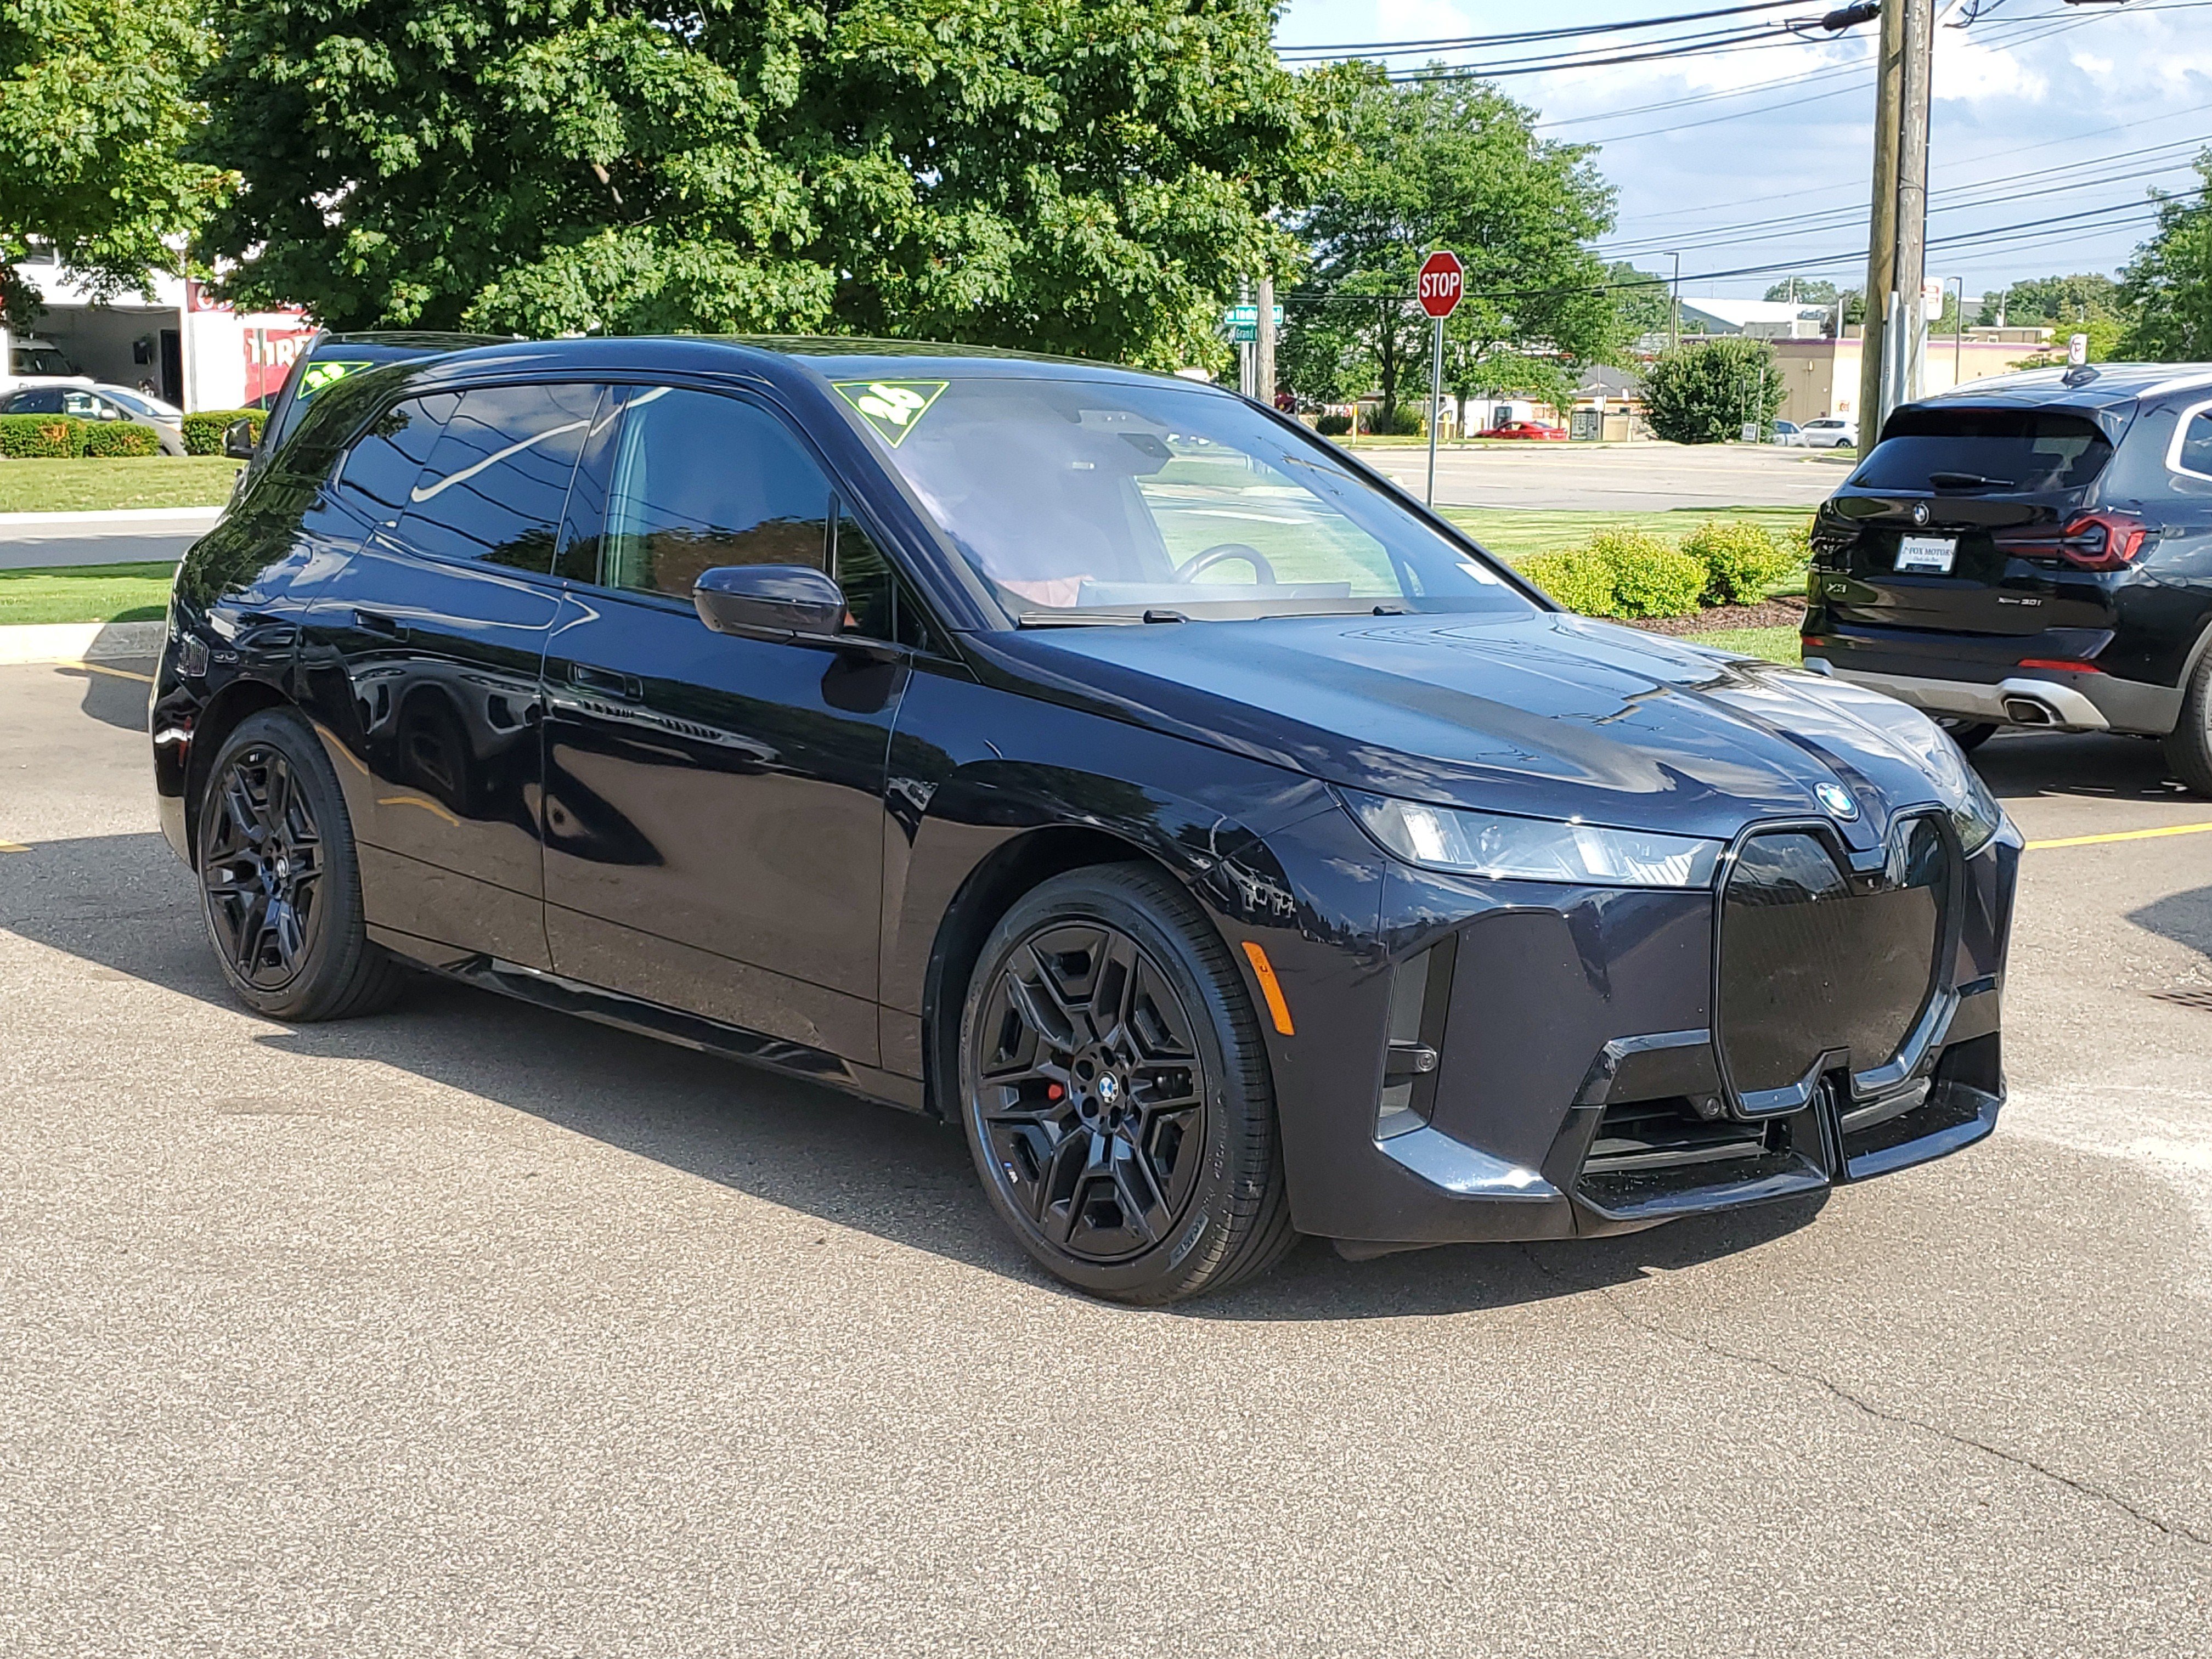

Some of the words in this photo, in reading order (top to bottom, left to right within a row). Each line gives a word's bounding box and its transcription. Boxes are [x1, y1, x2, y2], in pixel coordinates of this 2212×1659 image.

[1421, 272, 1459, 297] STOP
[1236, 327, 1253, 339] Grand
[1909, 547, 1923, 555] FOX
